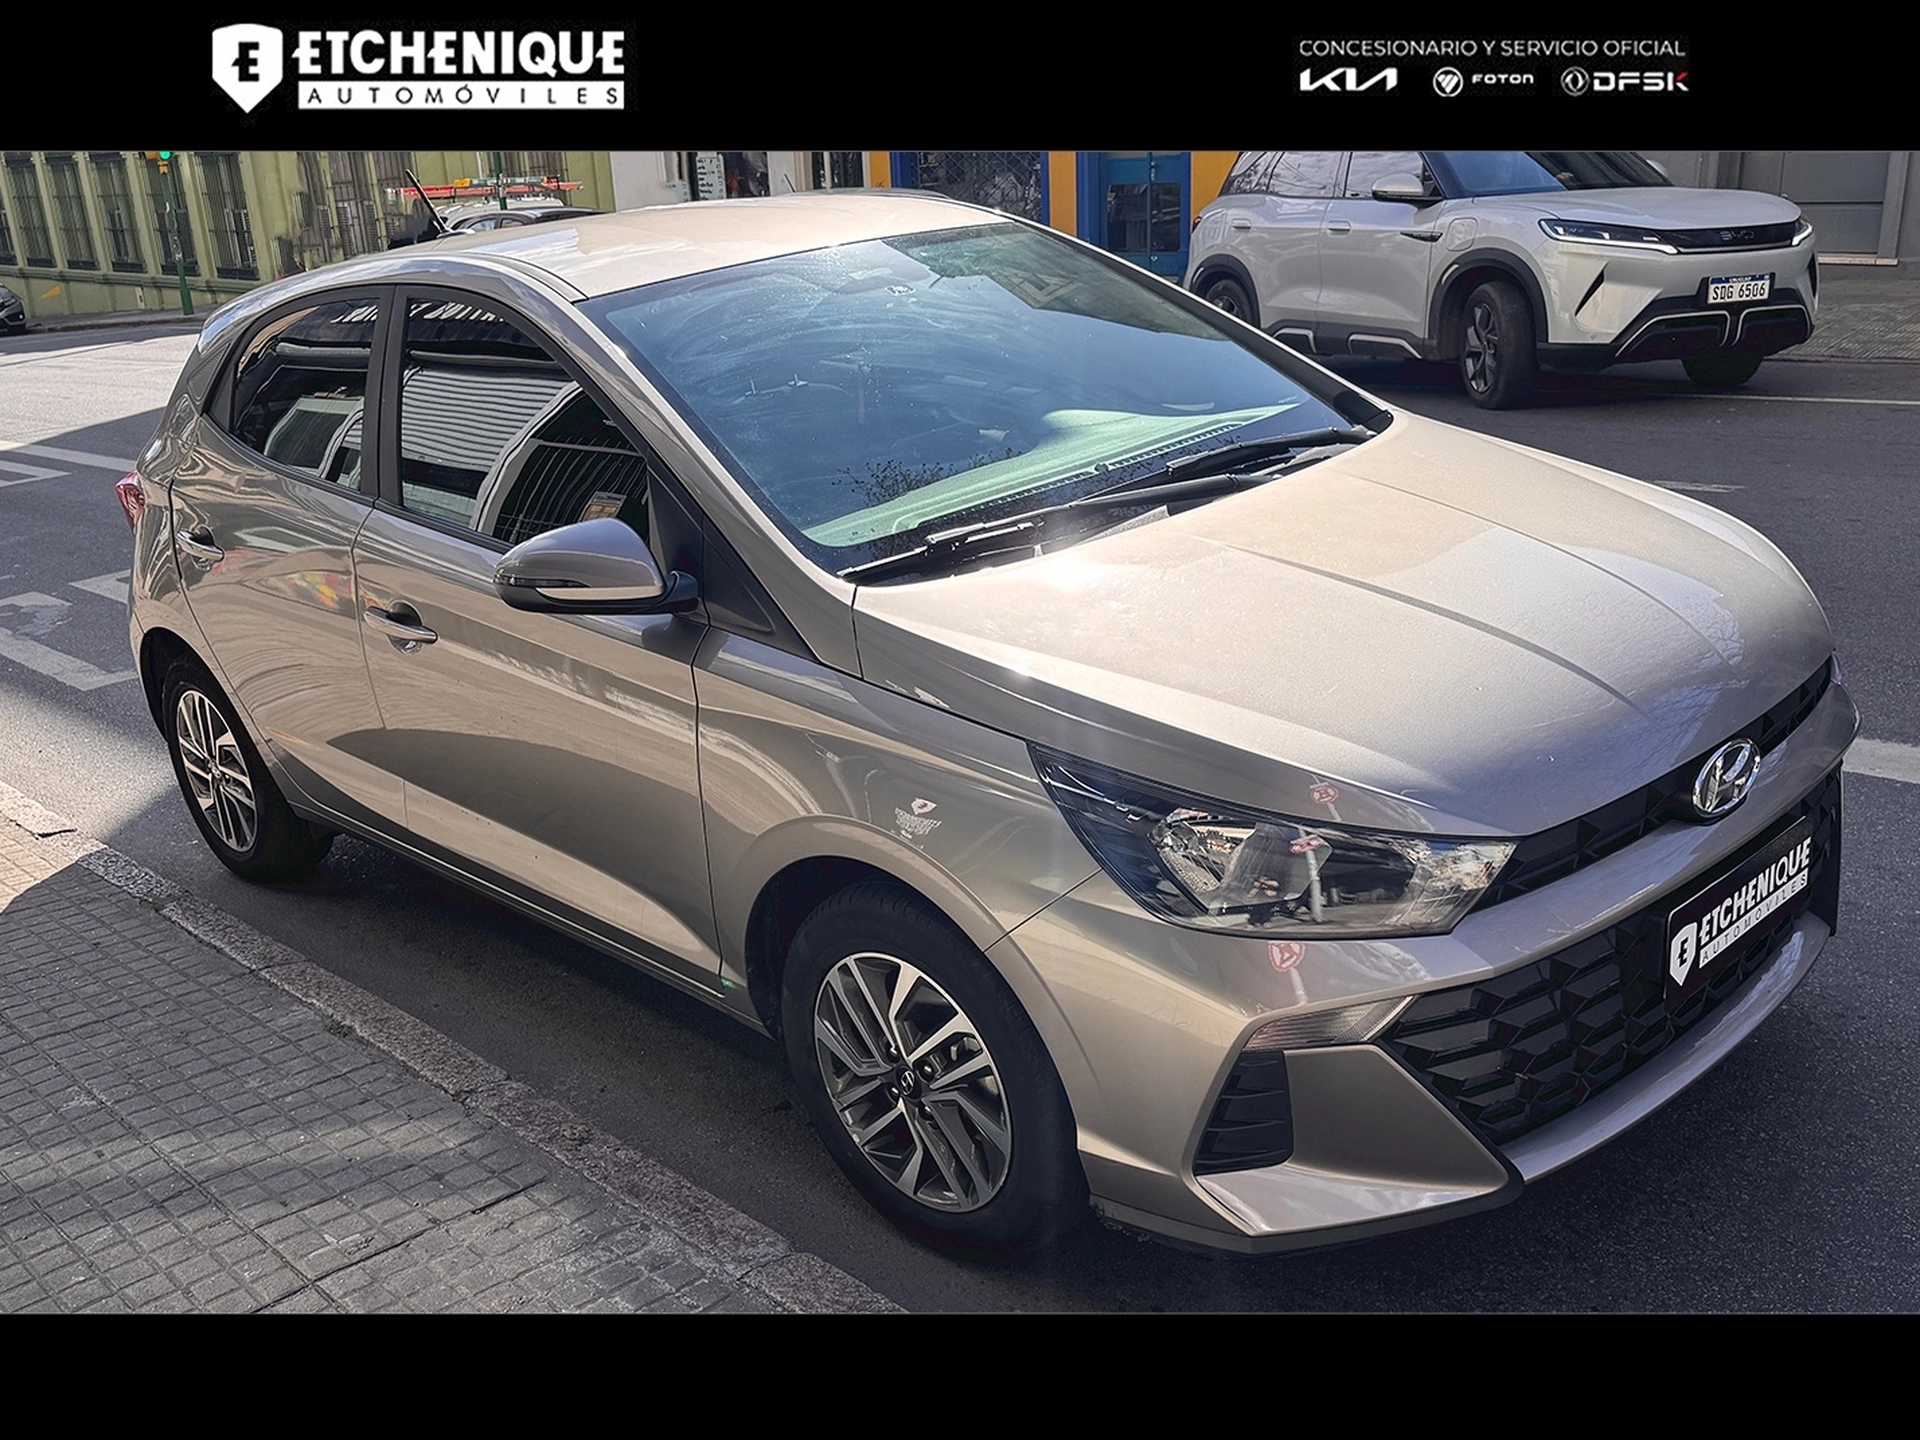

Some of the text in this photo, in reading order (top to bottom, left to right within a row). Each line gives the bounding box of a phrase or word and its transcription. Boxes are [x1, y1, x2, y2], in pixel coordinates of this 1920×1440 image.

[1712, 282, 1766, 301] SDG 6506
[1699, 836, 1812, 946] ETCHENIQUE
